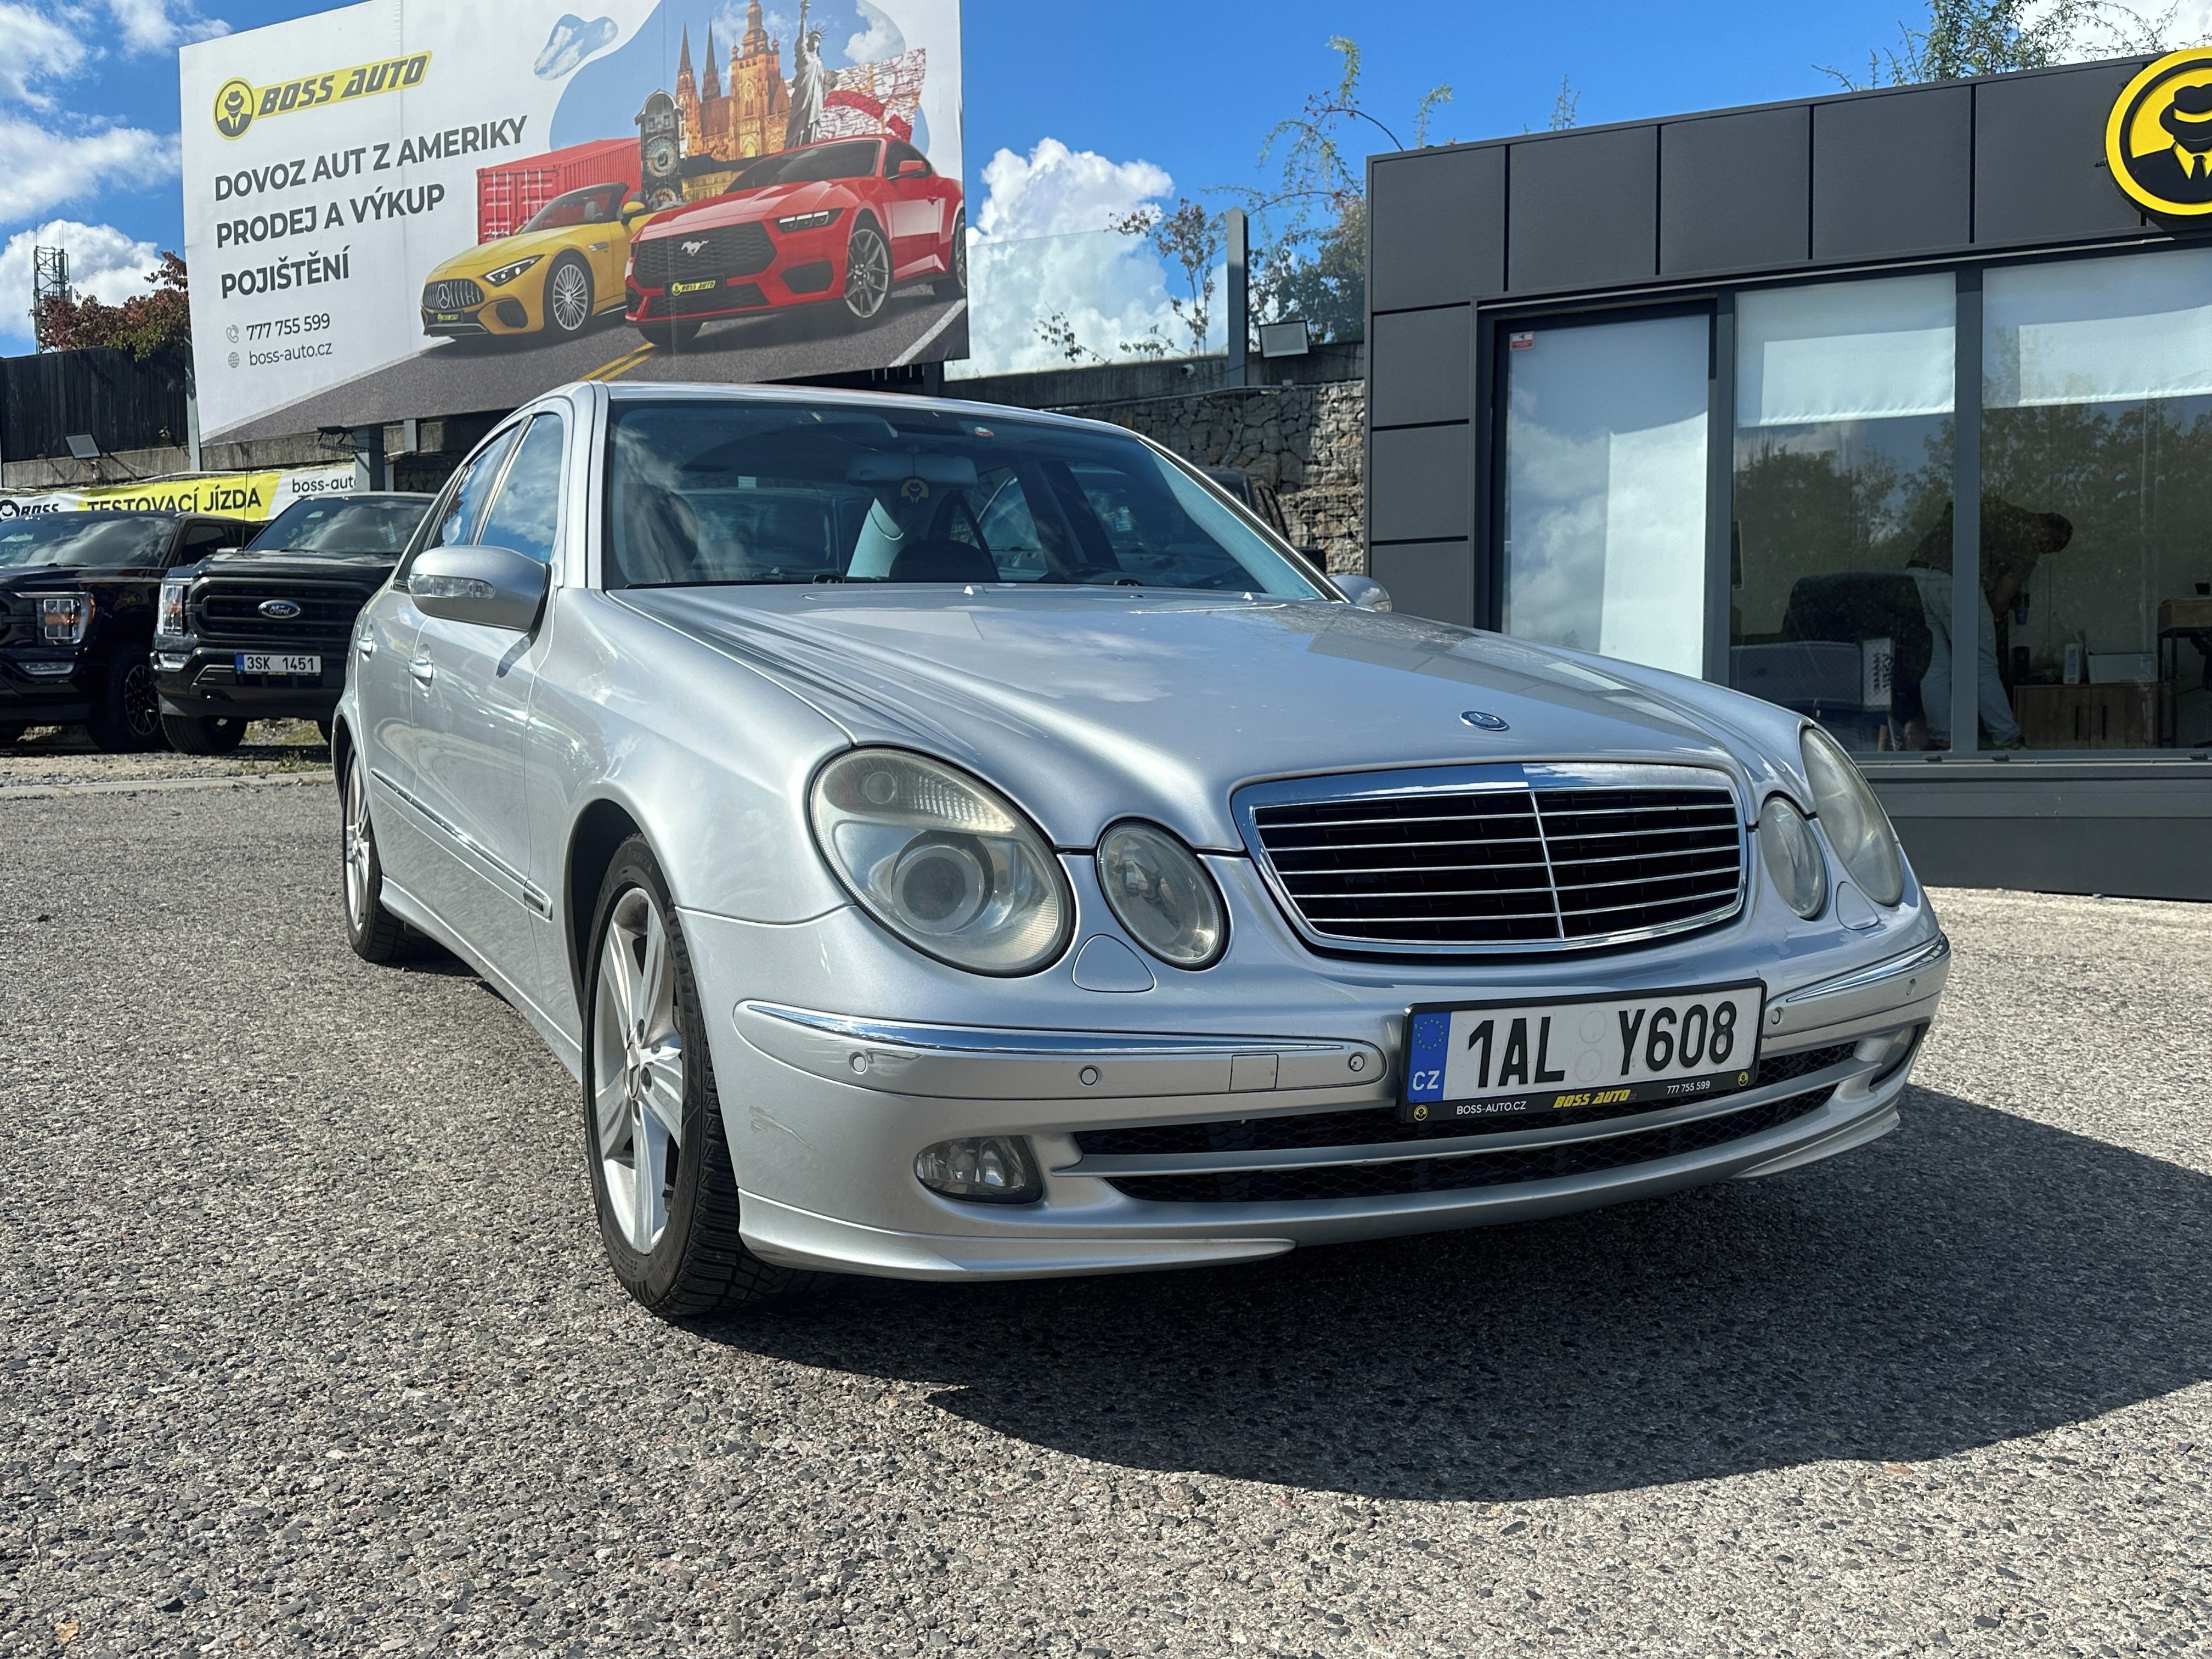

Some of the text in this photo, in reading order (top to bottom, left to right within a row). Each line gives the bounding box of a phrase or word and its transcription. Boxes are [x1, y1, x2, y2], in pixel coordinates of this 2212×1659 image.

[258, 55, 427, 116] BOSS AUTO
[215, 115, 528, 201] DOVOZ AUT Z AMERIKY
[217, 183, 445, 249] PRODEJ A VÝKUP
[221, 245, 351, 299] POJIŠTĚNÍ
[246, 313, 330, 341] 777 755 599
[249, 343, 333, 366] boss-auto.cz
[203, 484, 262, 512] JÍZDA
[269, 605, 291, 614] Ford
[247, 657, 314, 670] 3SK 1451
[1468, 1001, 1737, 1088] 1AL Y608
[1412, 1070, 1441, 1091] CZ
[1456, 1100, 1527, 1115] BOSS-AUTO.CZ
[1553, 1093, 1592, 1109] BOSS
[1592, 1089, 1631, 1105] AUTO
[1667, 1084, 1680, 1094] 777
[1681, 1082, 1695, 1093] 755
[1696, 1080, 1711, 1091] 599
